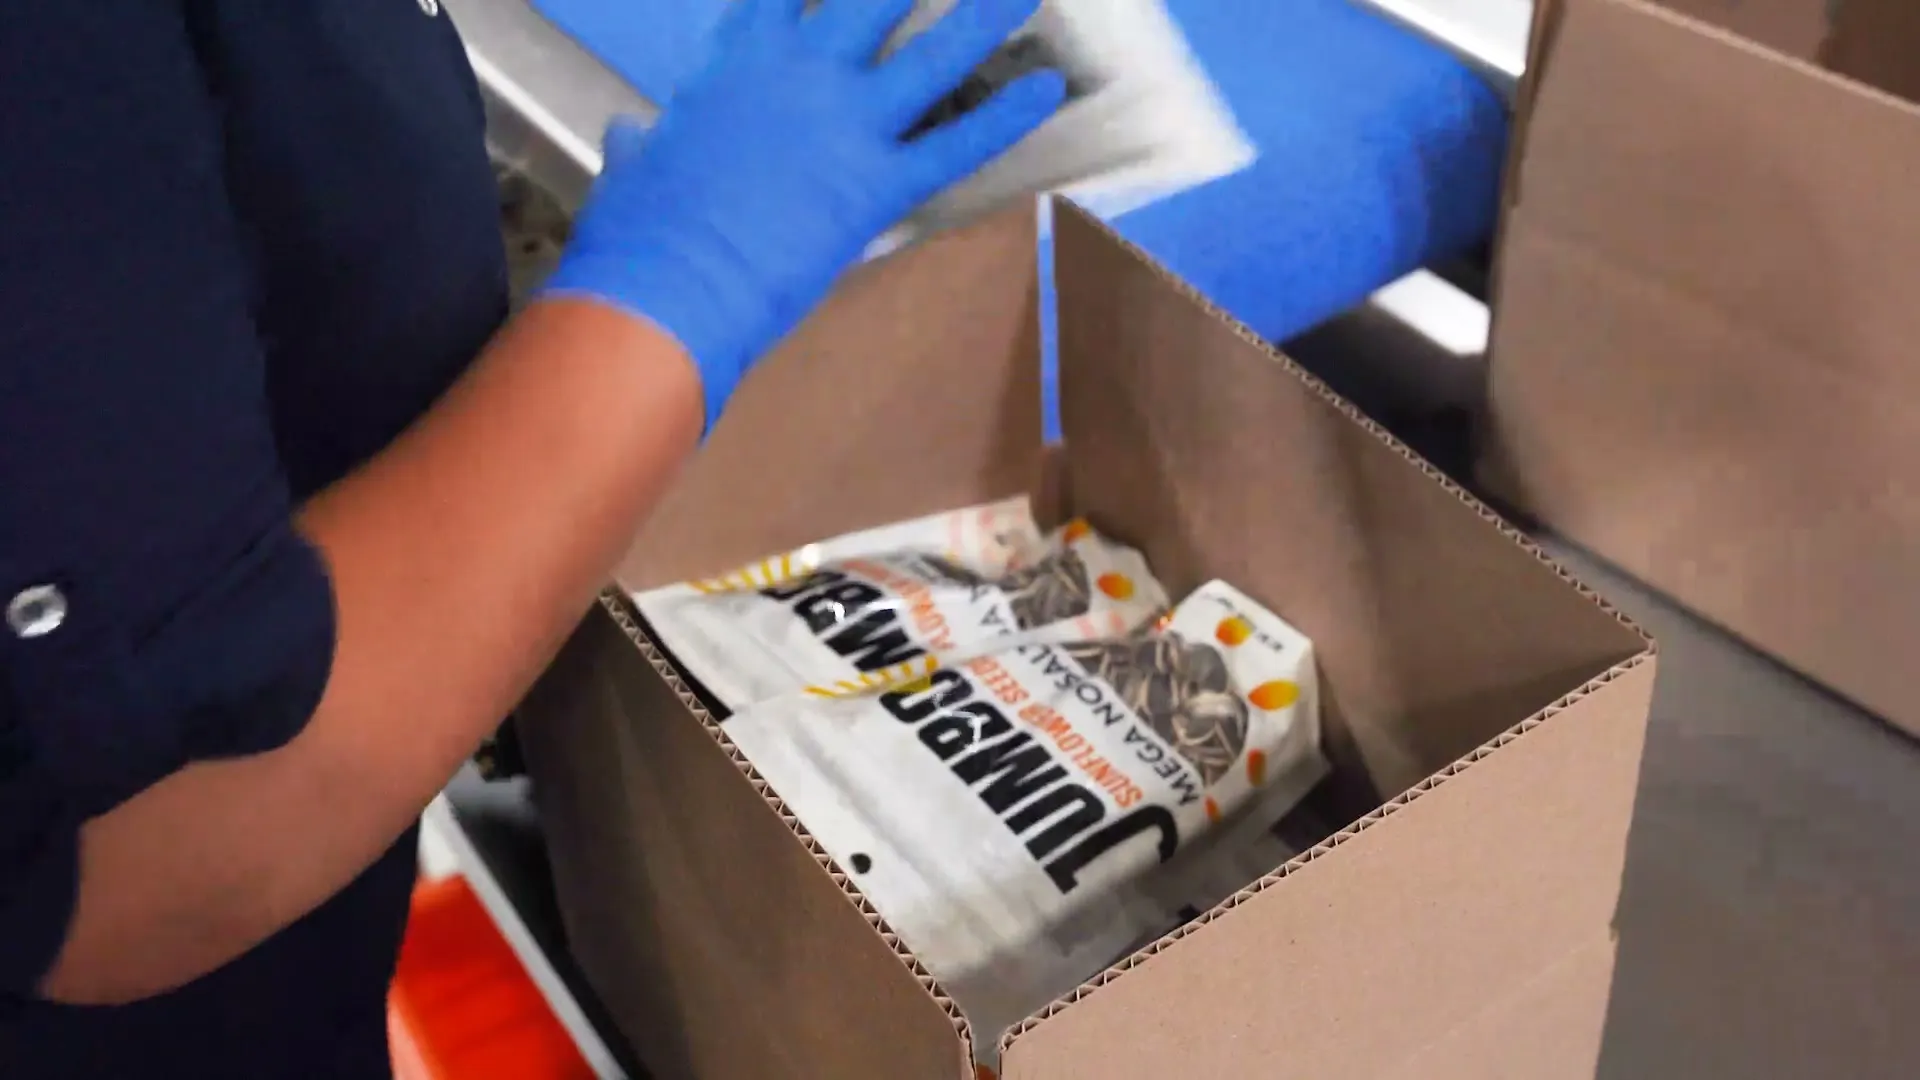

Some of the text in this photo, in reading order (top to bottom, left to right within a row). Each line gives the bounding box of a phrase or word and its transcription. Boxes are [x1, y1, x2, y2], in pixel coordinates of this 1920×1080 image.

[879, 668, 1178, 895] JUMBO
[1018, 702, 1144, 809] SUNFLOWER
[1123, 724, 1201, 807] MEGA
